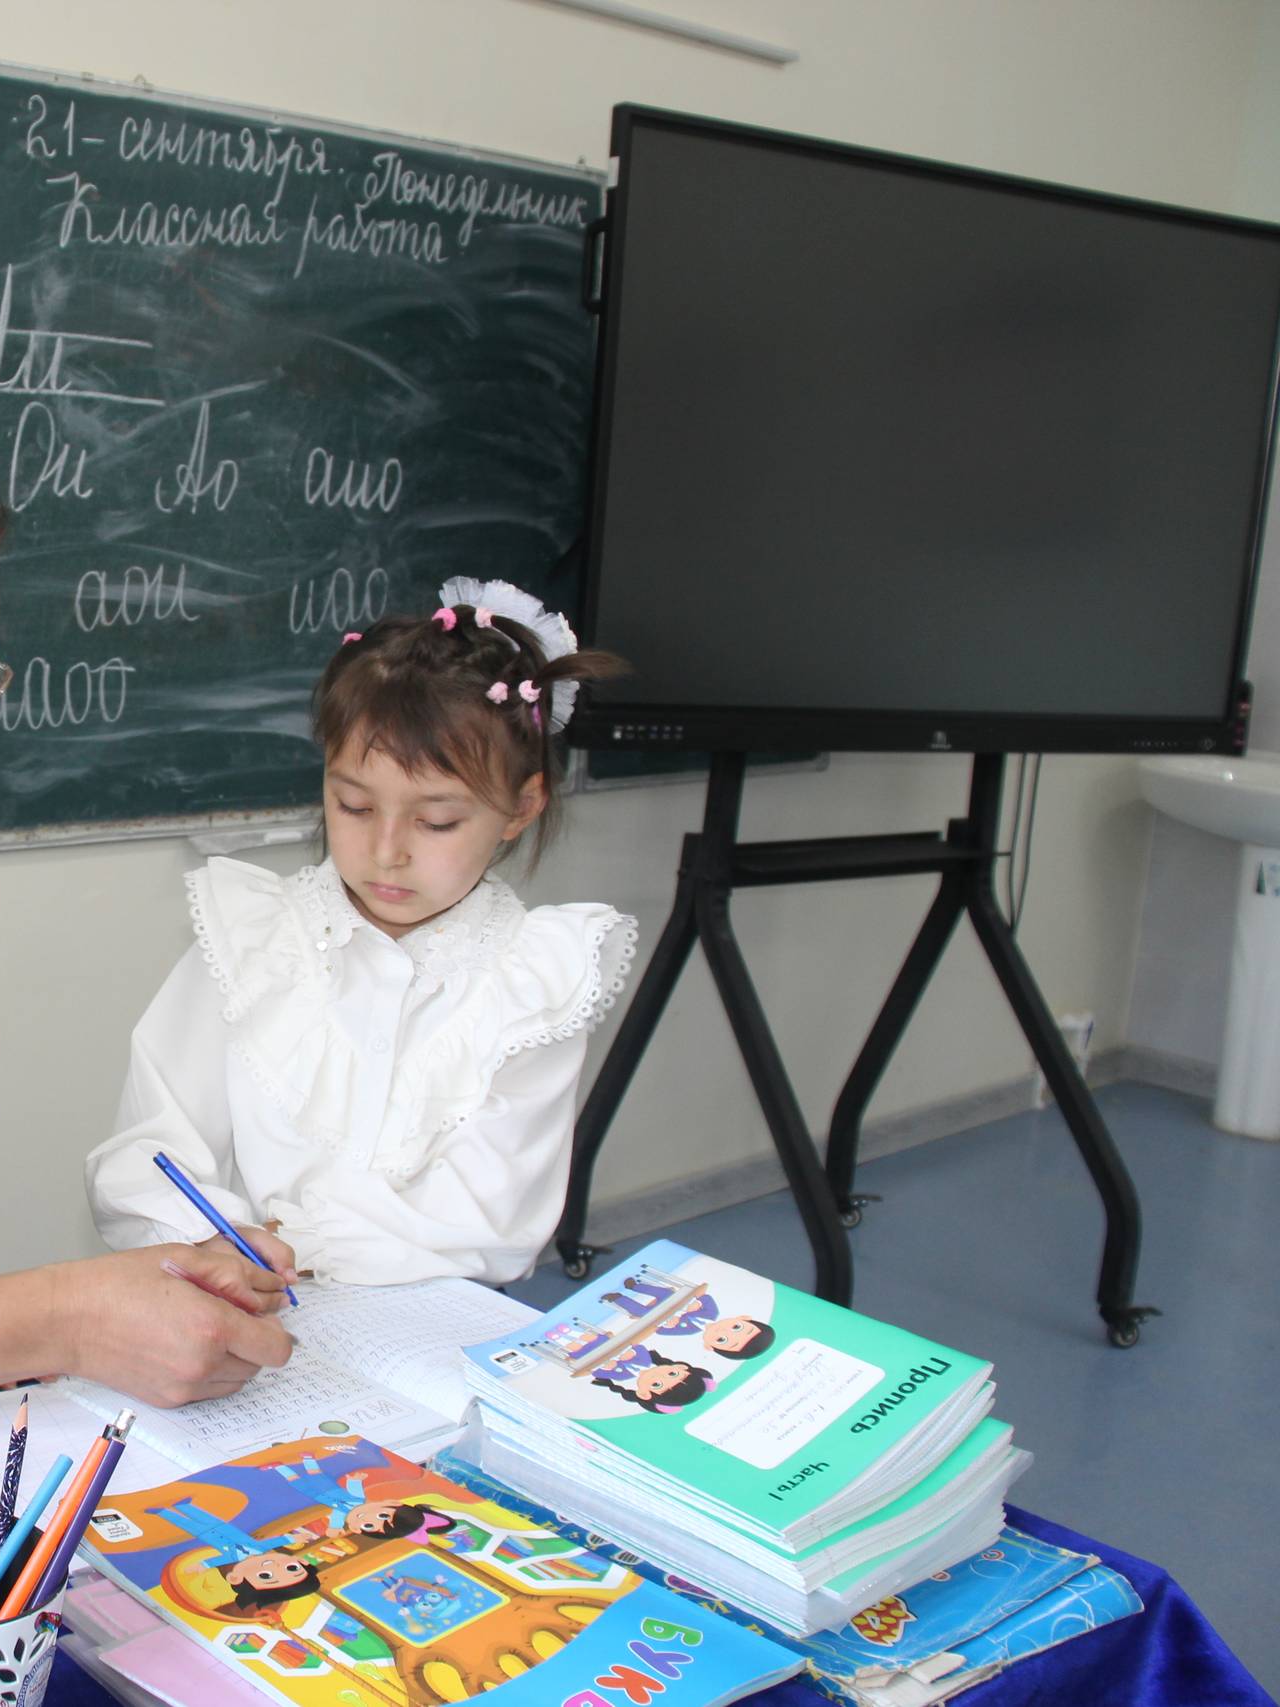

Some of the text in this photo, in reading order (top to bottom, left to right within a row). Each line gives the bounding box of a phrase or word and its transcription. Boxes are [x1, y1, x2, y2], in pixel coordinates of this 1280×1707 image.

[45, 171, 285, 248] Классная
[850, 1356, 953, 1434] Пропись
[776, 1460, 831, 1494] Часть
